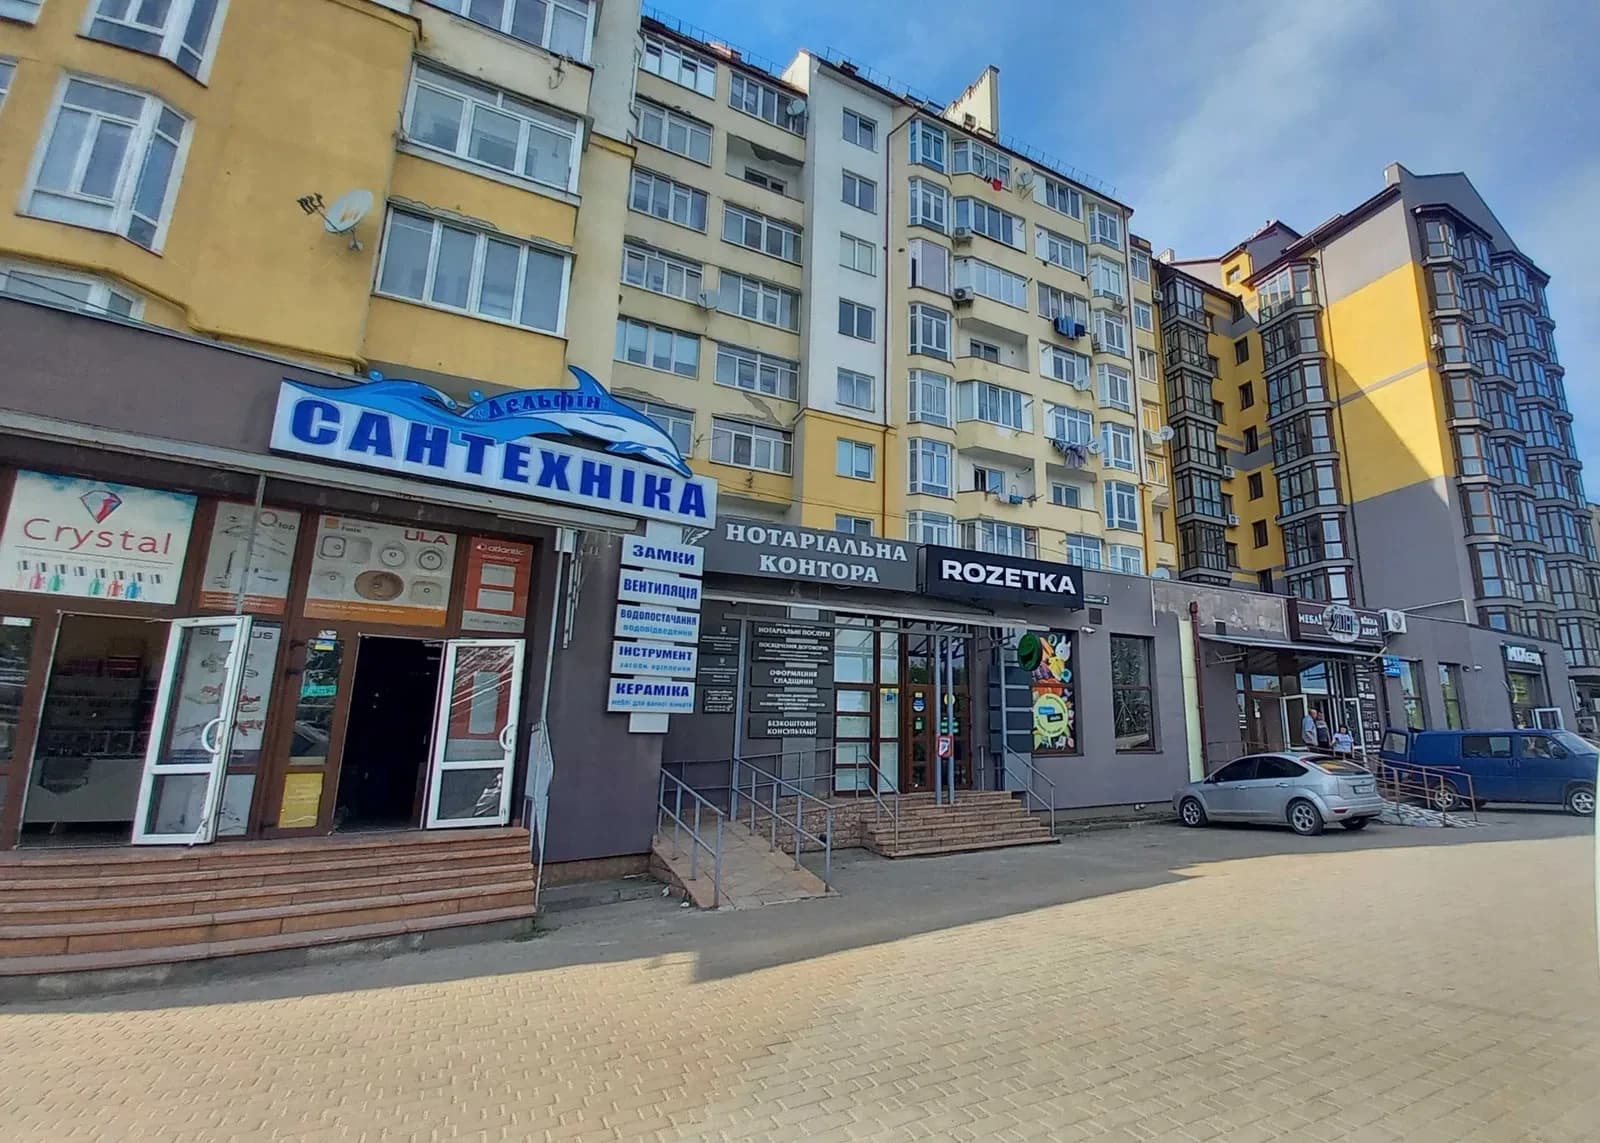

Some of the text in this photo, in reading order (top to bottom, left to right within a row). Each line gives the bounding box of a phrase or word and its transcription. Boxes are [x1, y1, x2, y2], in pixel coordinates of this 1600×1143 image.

[488, 391, 600, 419] Дельфін
[291, 398, 707, 518] САНТЕХНІКА
[23, 517, 172, 555] Crystal
[404, 528, 449, 546] ULA
[726, 523, 909, 562] НОТАРІАЛЬНА
[487, 542, 525, 556] atlantic
[632, 544, 696, 566] ЗАМКИ
[759, 554, 880, 583] КОНТОРА
[941, 559, 1077, 595] ROZETKA
[623, 578, 698, 600] ВЕНТИЛЯЦІЯ
[620, 608, 697, 626] ВОДОПОСТАЧАННЯ
[758, 626, 801, 635] НОТАРІАЛЬНІ
[618, 645, 693, 661] ІНСТРУМЕНТ
[769, 669, 818, 677] ОФОРМЛЕННЯ
[773, 677, 814, 685] СПАДЩИНИ
[615, 682, 690, 697] КЕРАМІКА
[767, 719, 817, 727] БЕЗКОШТОВНІ
[767, 727, 817, 735] КОНСУЛЬТАЦІЇ
